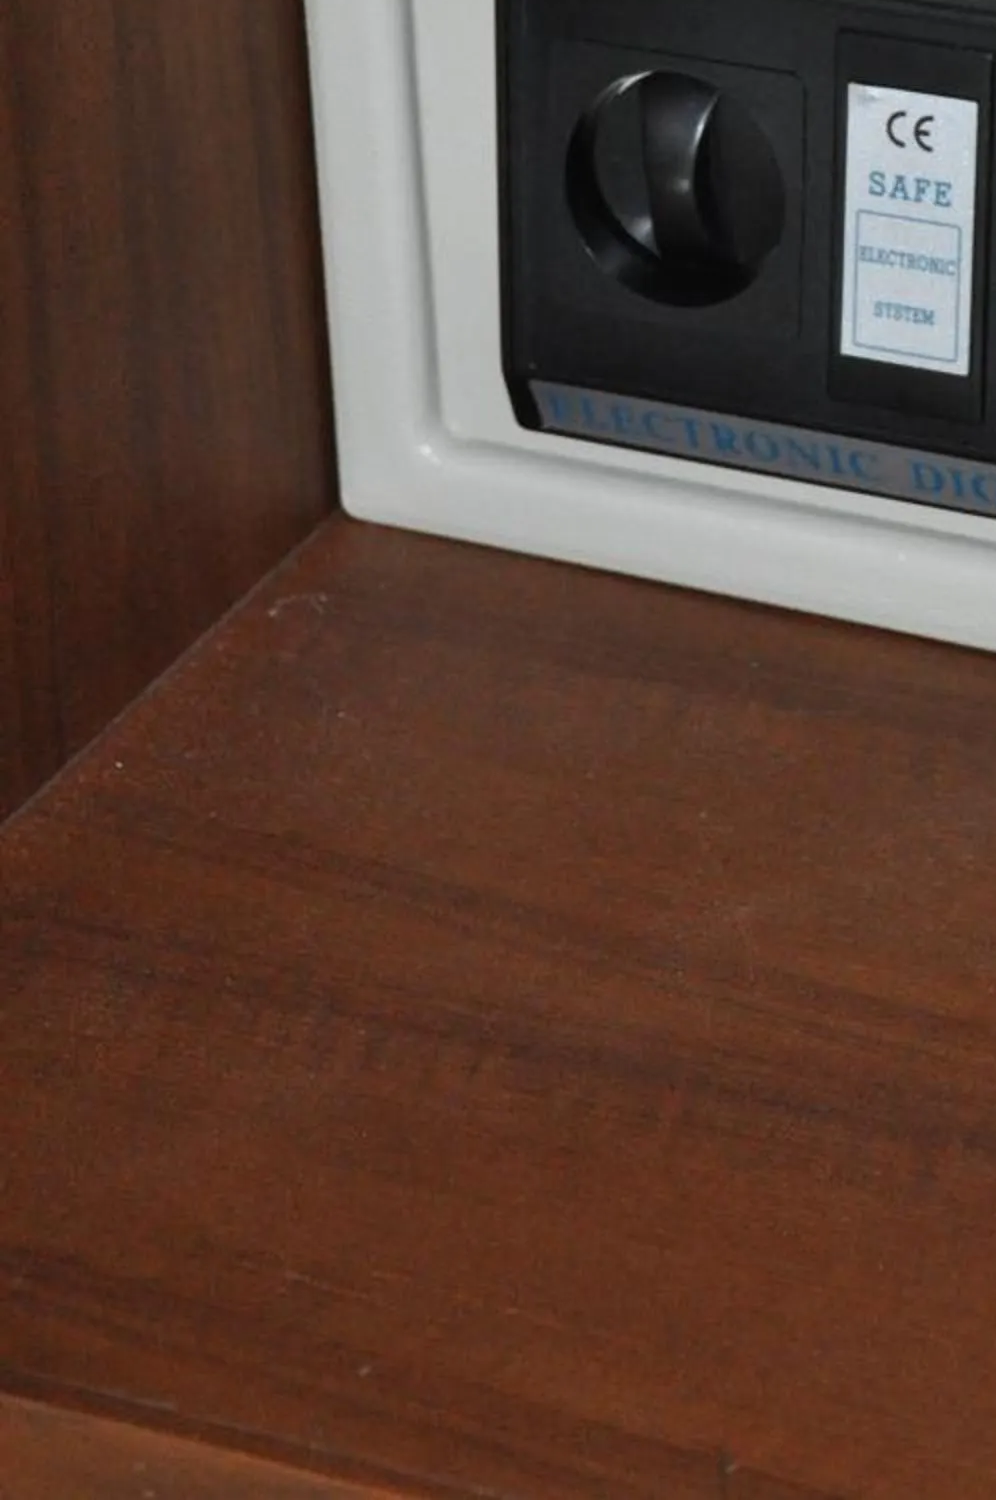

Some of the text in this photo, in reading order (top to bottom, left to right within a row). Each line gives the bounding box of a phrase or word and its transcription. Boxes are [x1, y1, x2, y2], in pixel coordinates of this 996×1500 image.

[886, 110, 934, 152] CE
[868, 171, 952, 208] SAFE
[858, 245, 957, 277] ELECTRONIC
[873, 301, 936, 326] SYSTEM
[543, 388, 882, 482] ELECTRONIC
